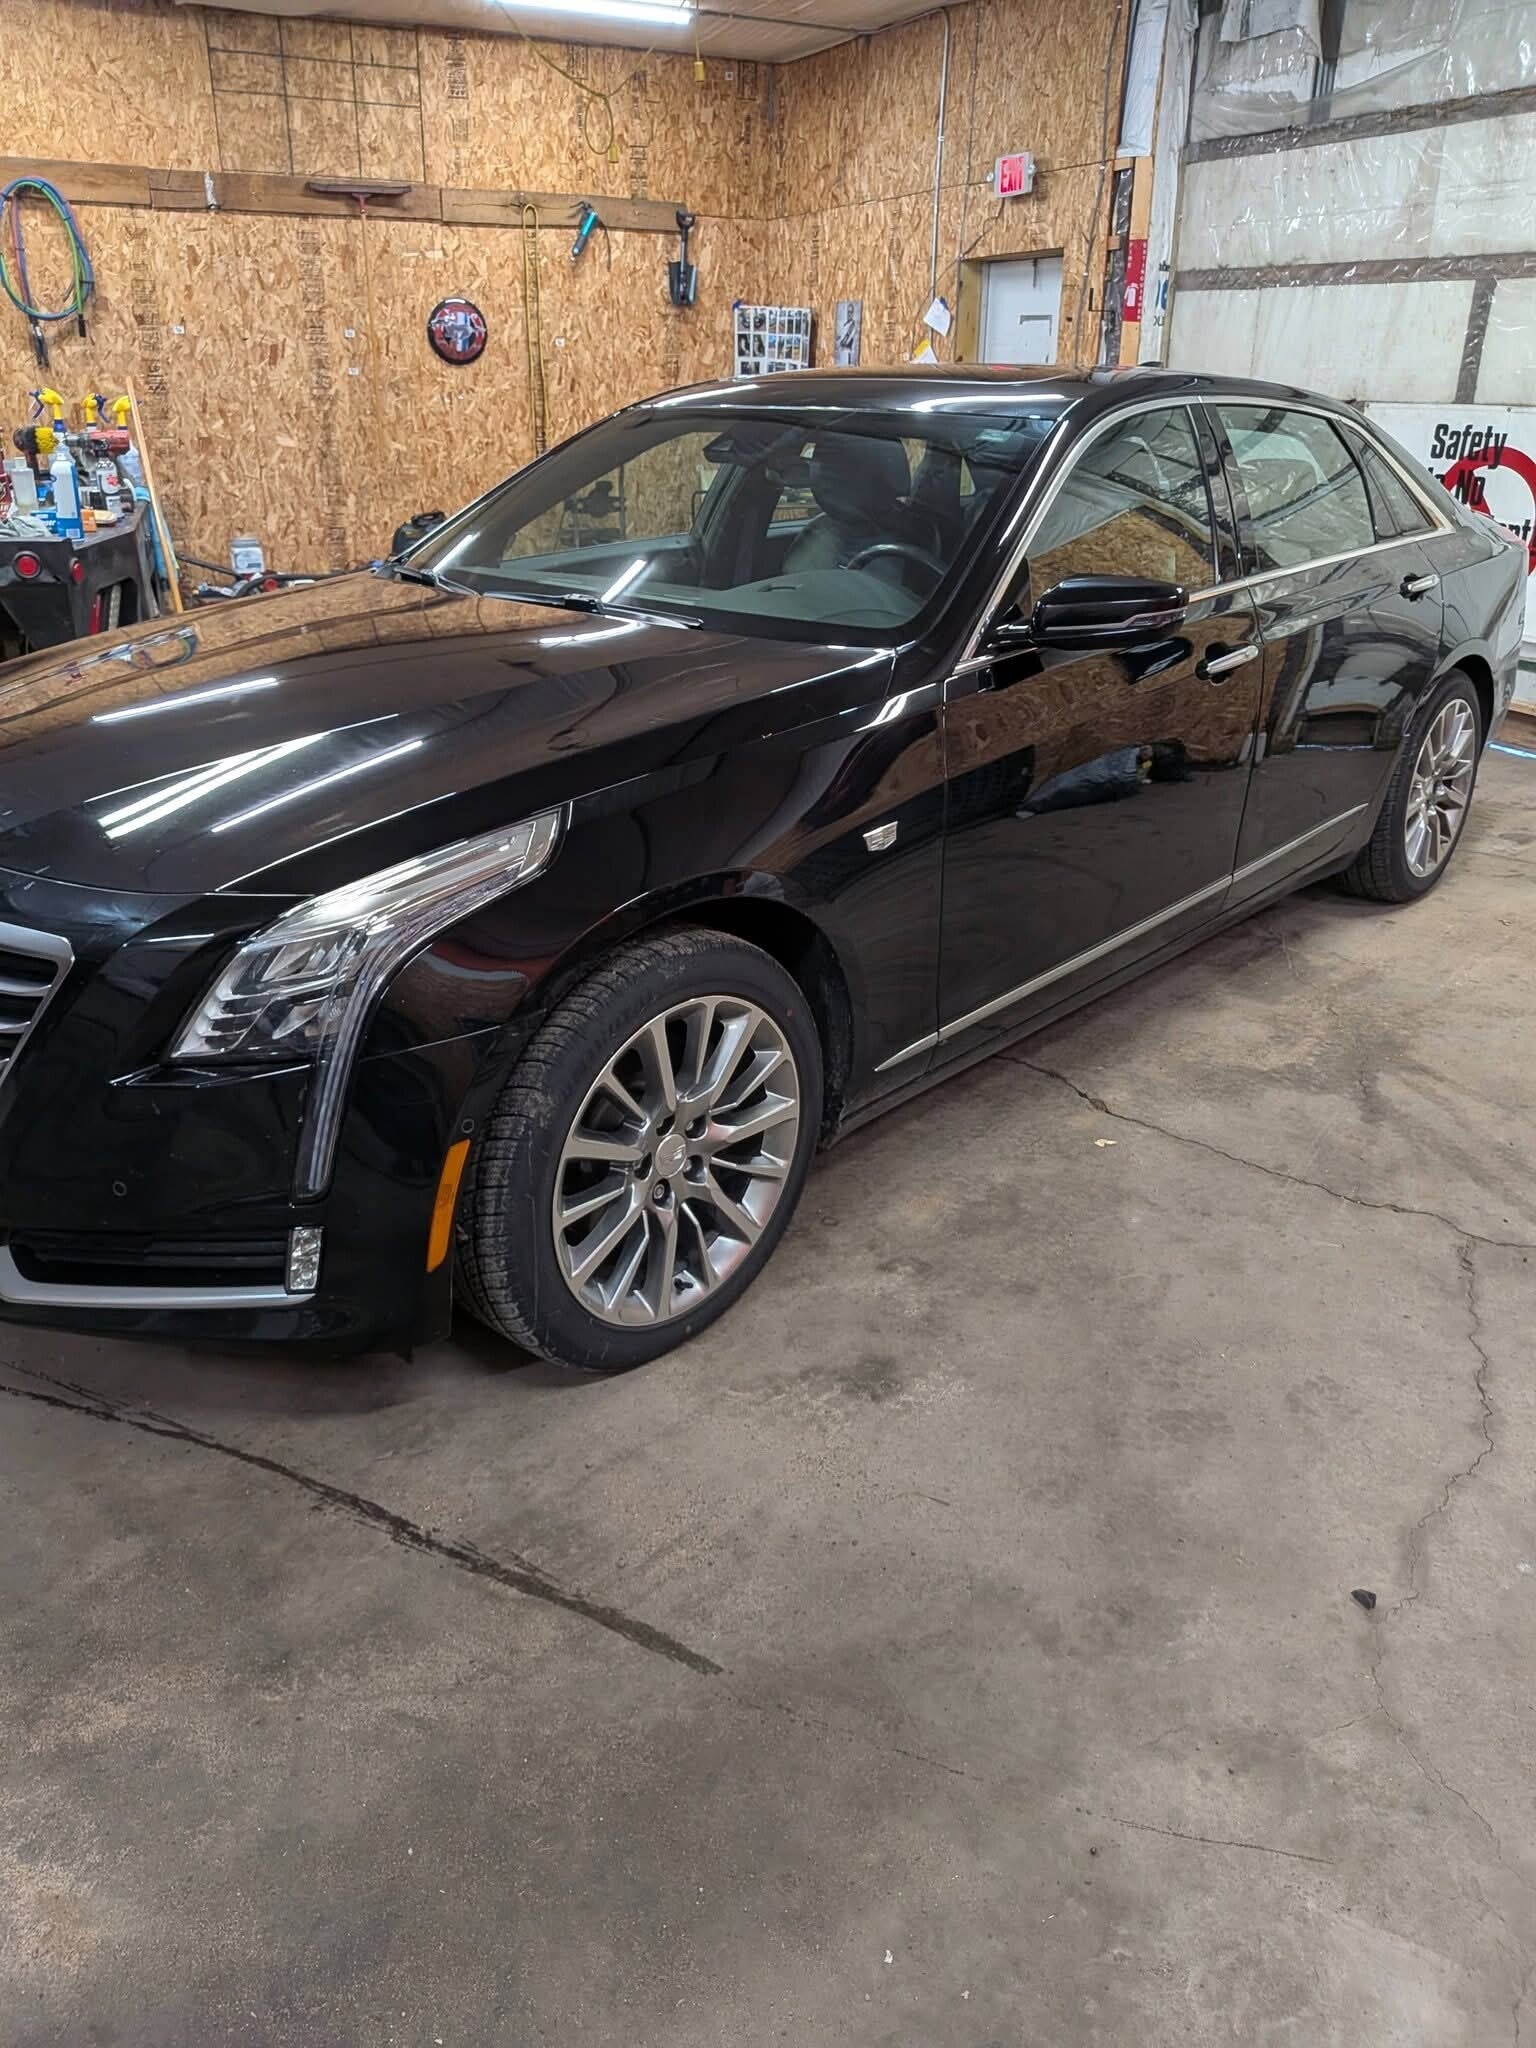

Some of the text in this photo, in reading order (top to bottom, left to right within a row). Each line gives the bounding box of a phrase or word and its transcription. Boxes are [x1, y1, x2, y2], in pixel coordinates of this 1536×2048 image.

[1000, 156, 1024, 193] EXIT
[1430, 423, 1508, 469] Safety
[1454, 469, 1486, 505] No
